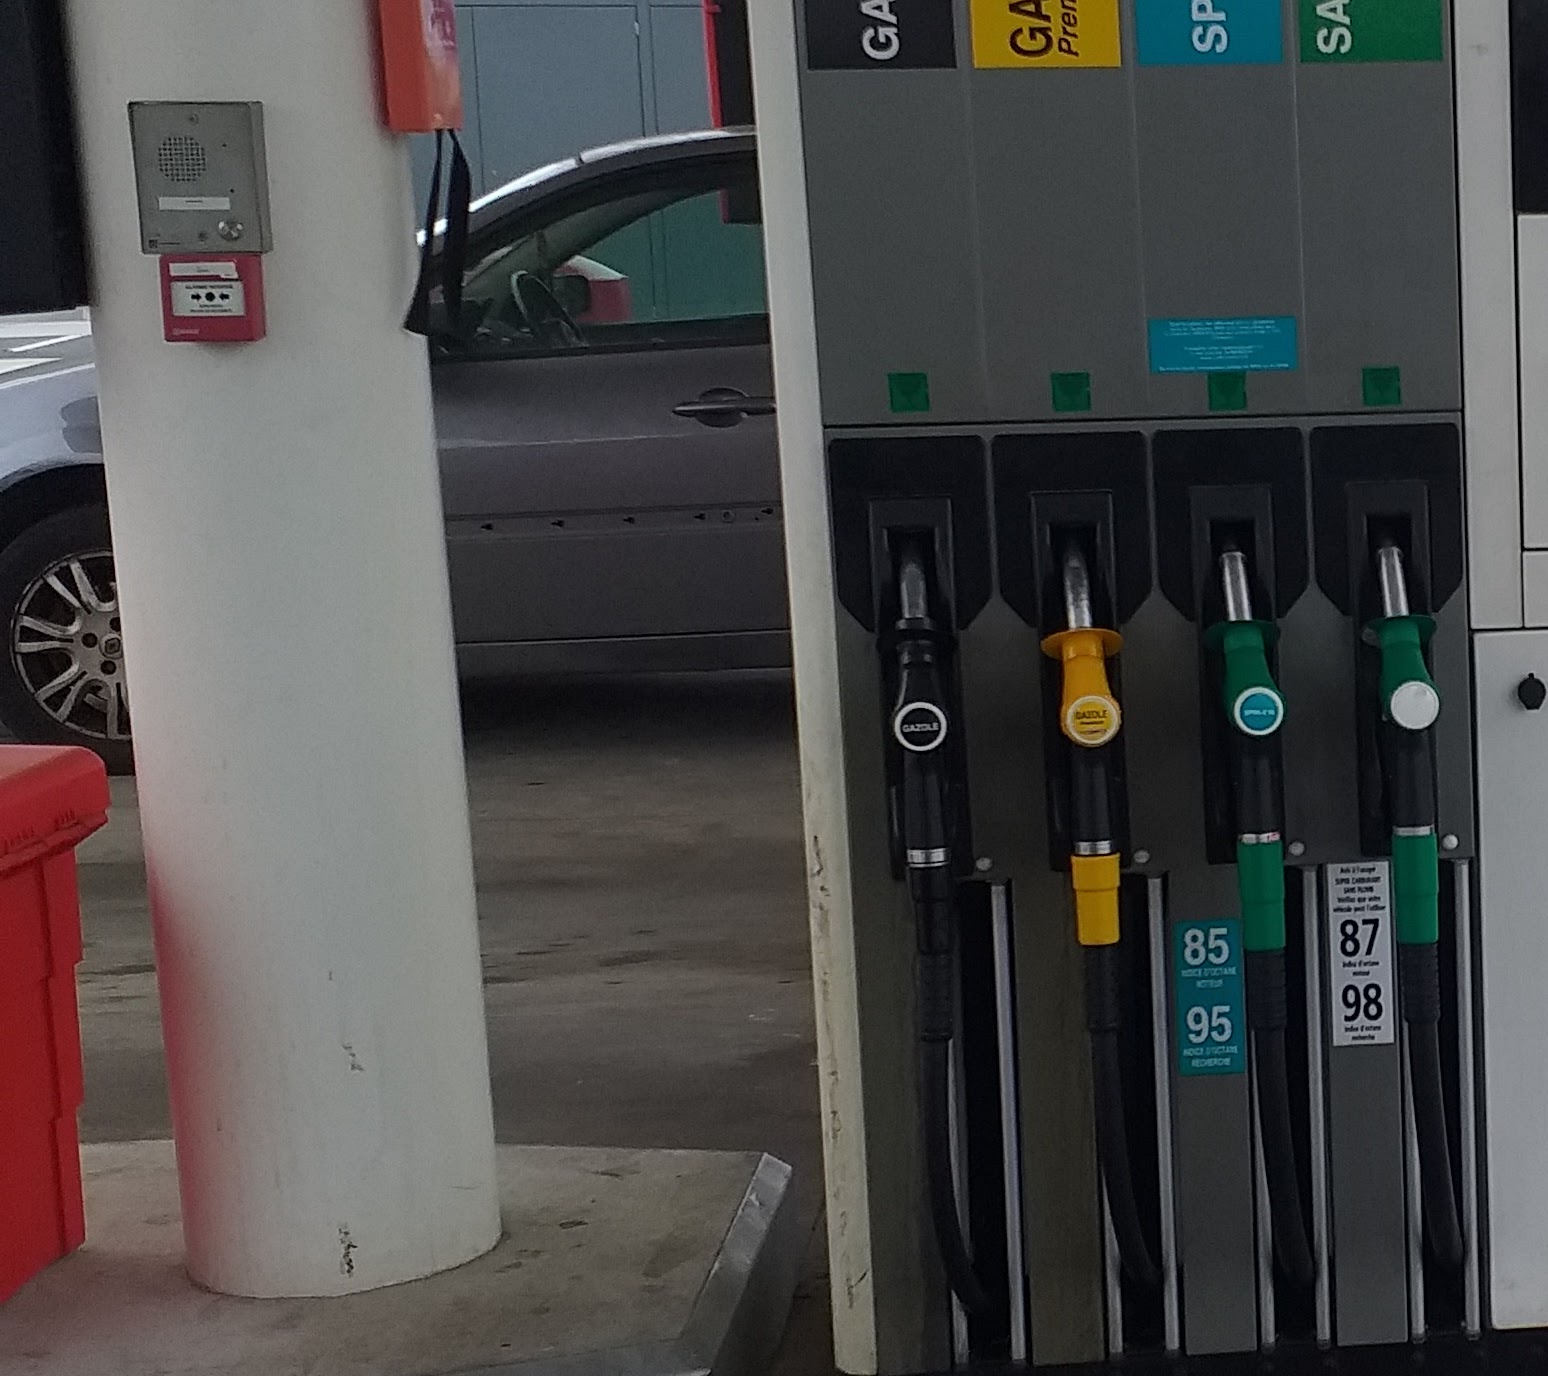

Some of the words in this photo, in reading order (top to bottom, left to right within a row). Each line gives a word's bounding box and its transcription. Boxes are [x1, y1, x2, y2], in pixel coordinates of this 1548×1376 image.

[902, 722, 940, 733] GAZOLE
[1184, 928, 1229, 965] 85
[1340, 918, 1380, 957] 87
[1341, 984, 1383, 1022] 98
[1187, 1006, 1232, 1043] 95
